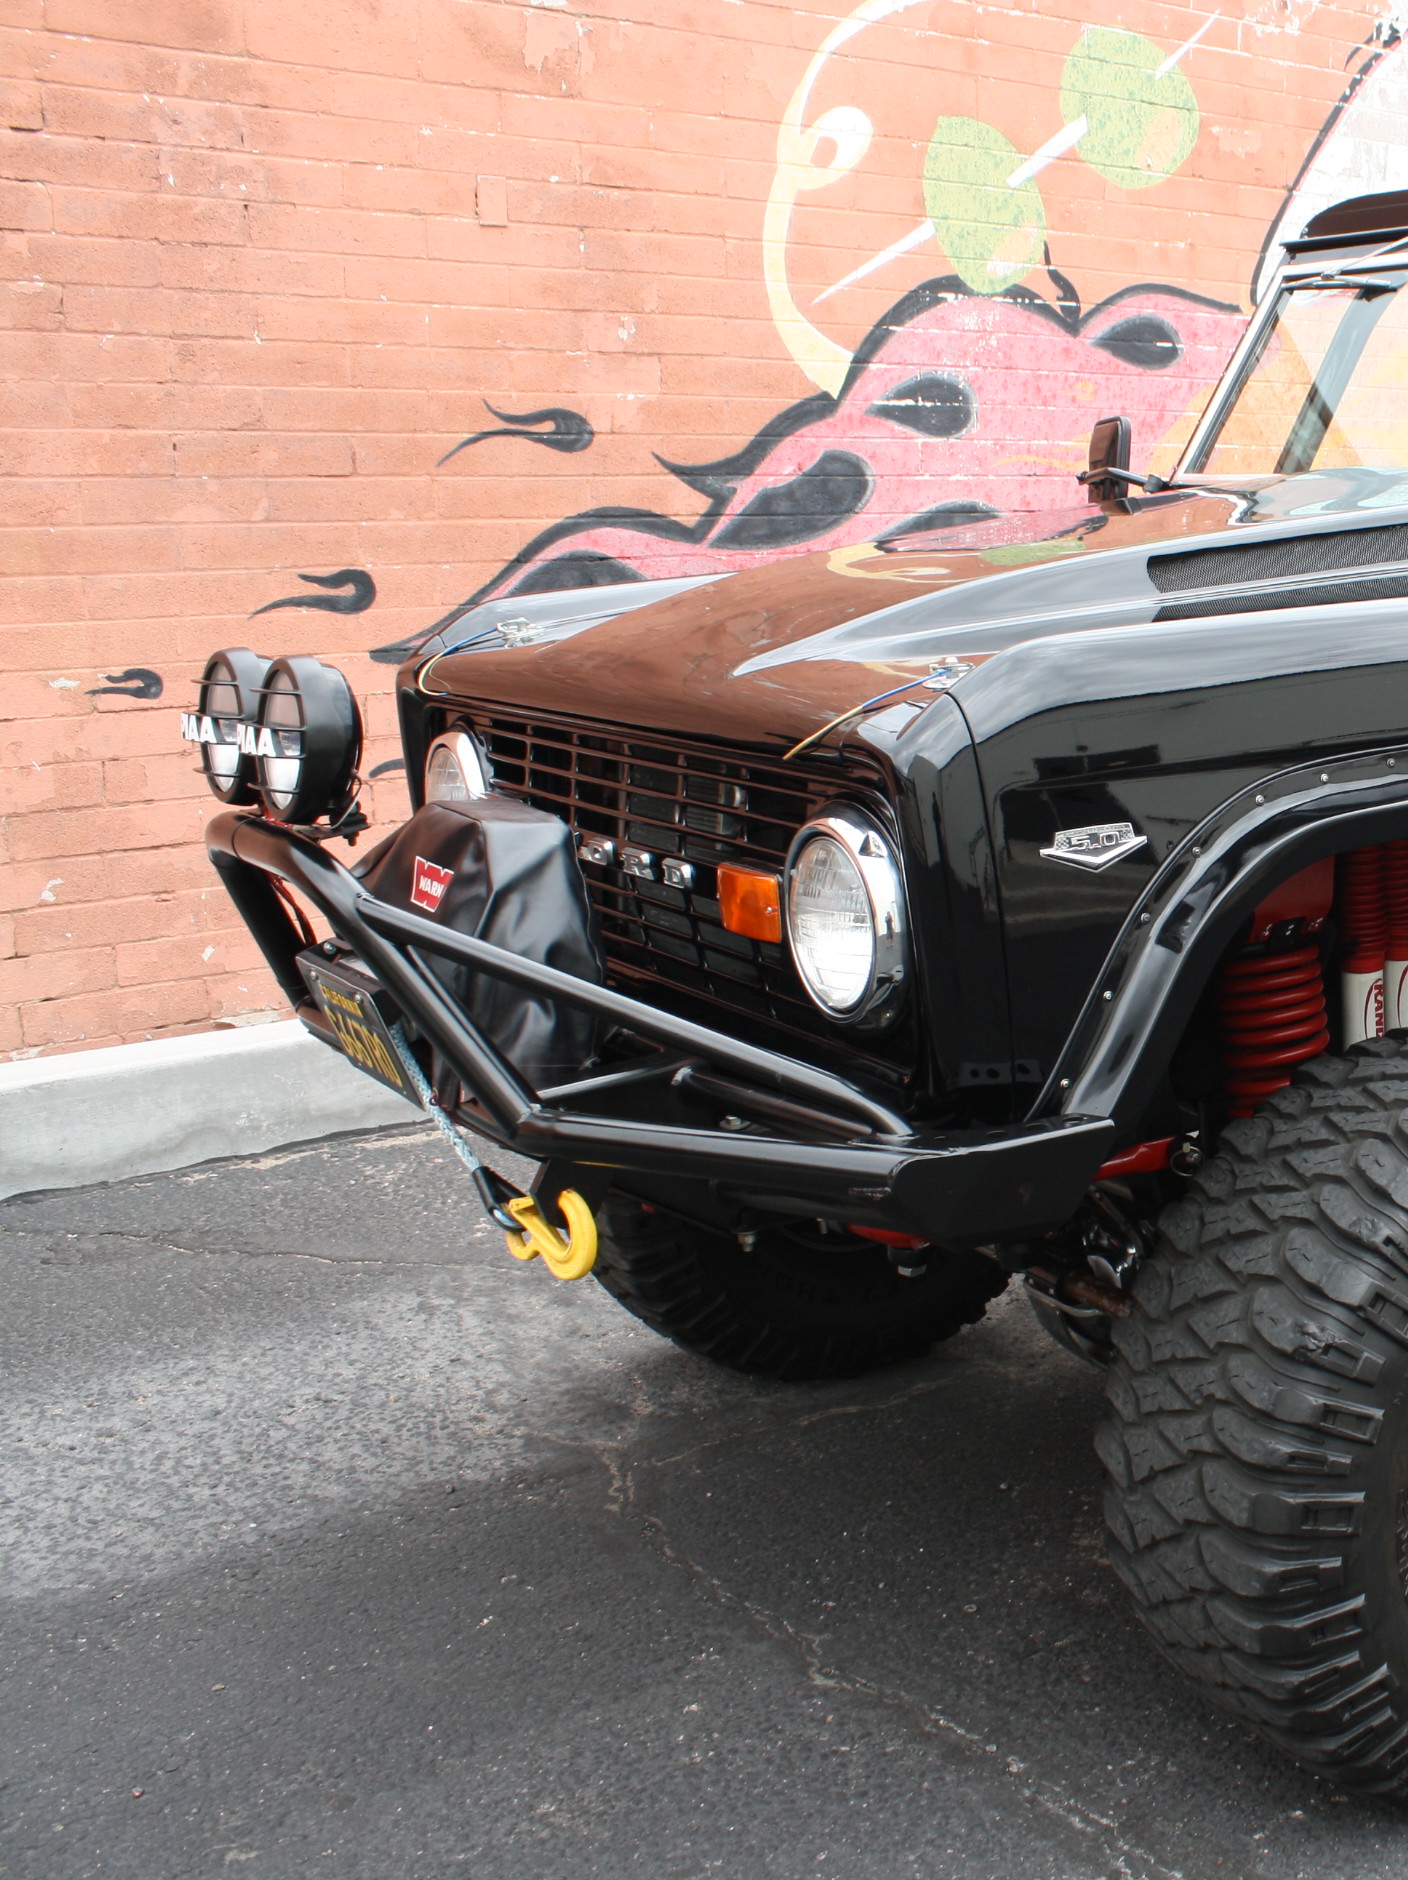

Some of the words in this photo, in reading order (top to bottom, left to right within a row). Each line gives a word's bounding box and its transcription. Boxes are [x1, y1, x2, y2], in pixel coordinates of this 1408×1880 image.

[1071, 831, 1121, 852] 5.0
[578, 837, 693, 889] ORD
[419, 874, 445, 898] WARN
